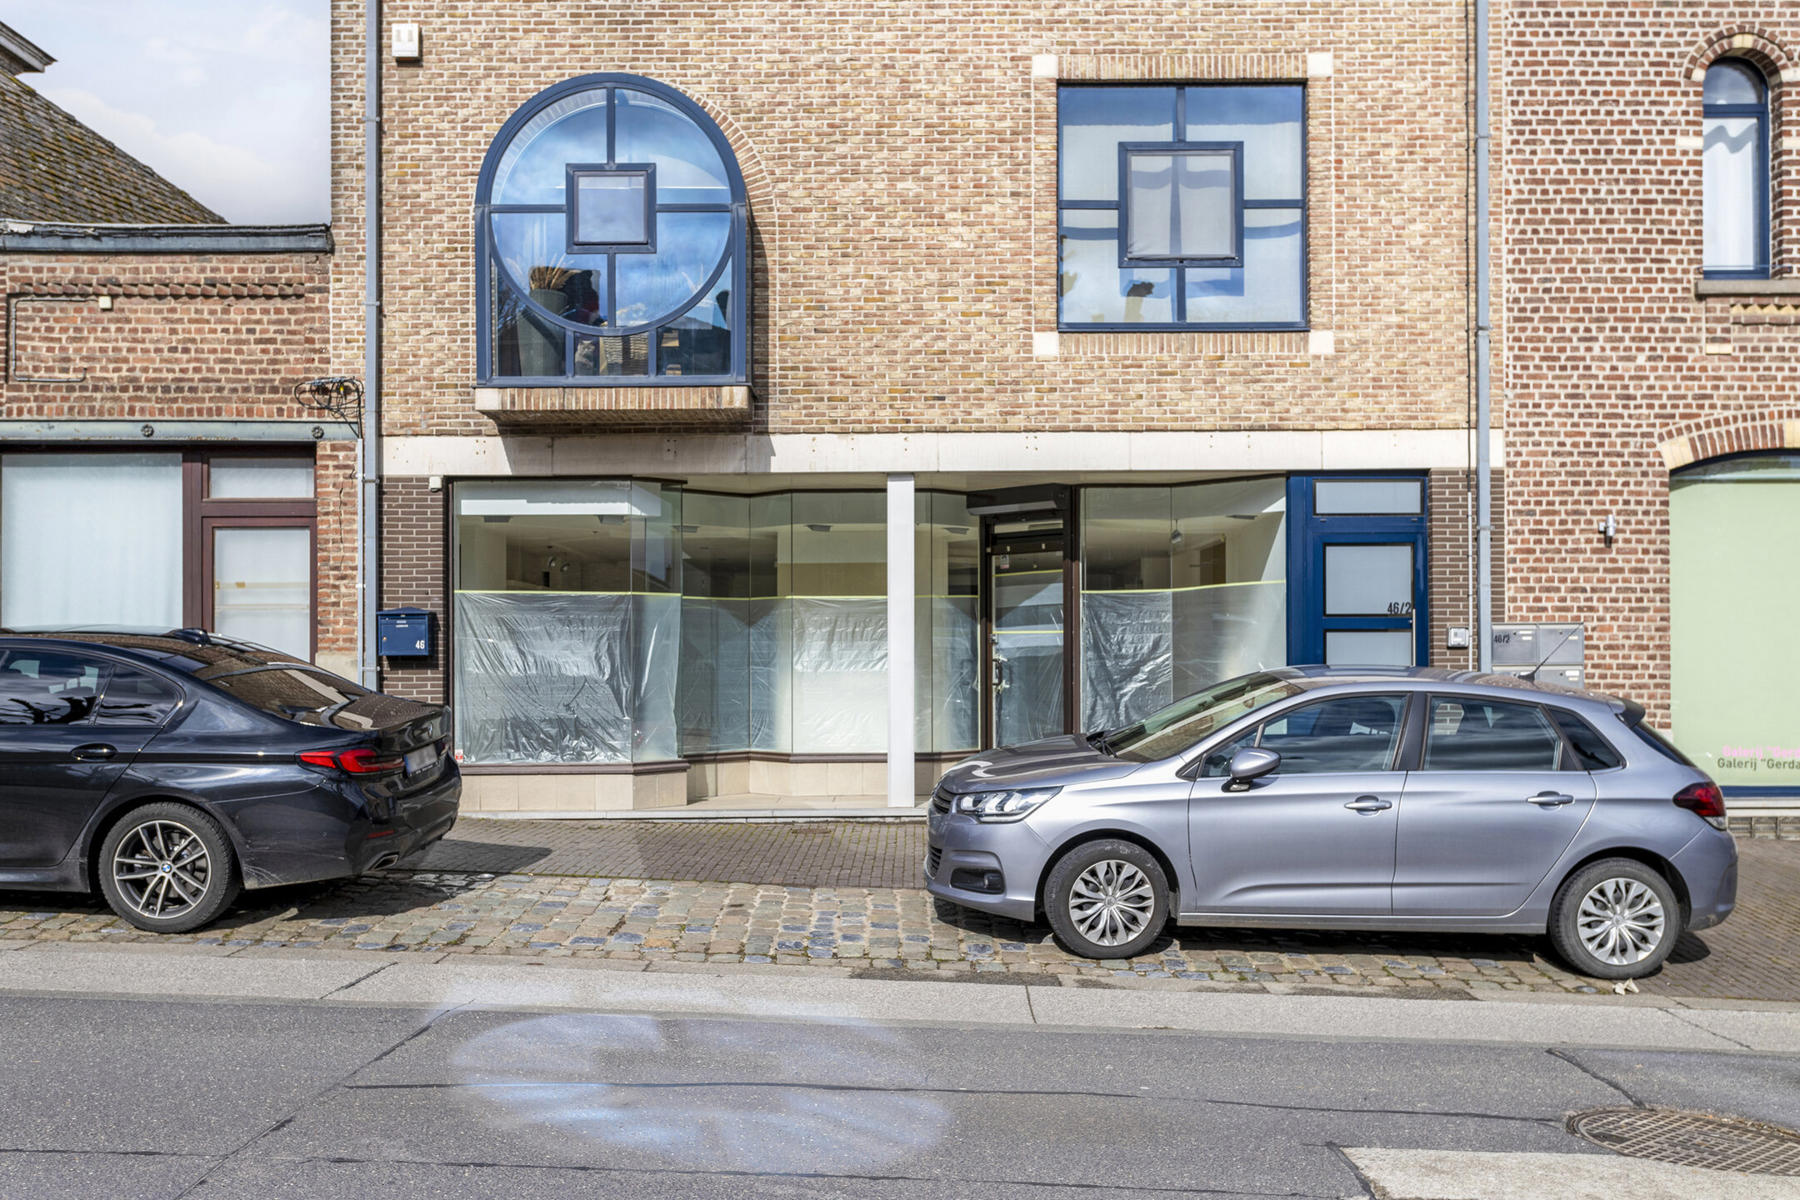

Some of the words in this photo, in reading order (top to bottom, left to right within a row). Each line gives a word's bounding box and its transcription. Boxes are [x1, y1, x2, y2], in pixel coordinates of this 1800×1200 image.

[1387, 602, 1411, 614] 46/2
[415, 640, 425, 649] 46
[1717, 757, 1757, 771] Galerij
